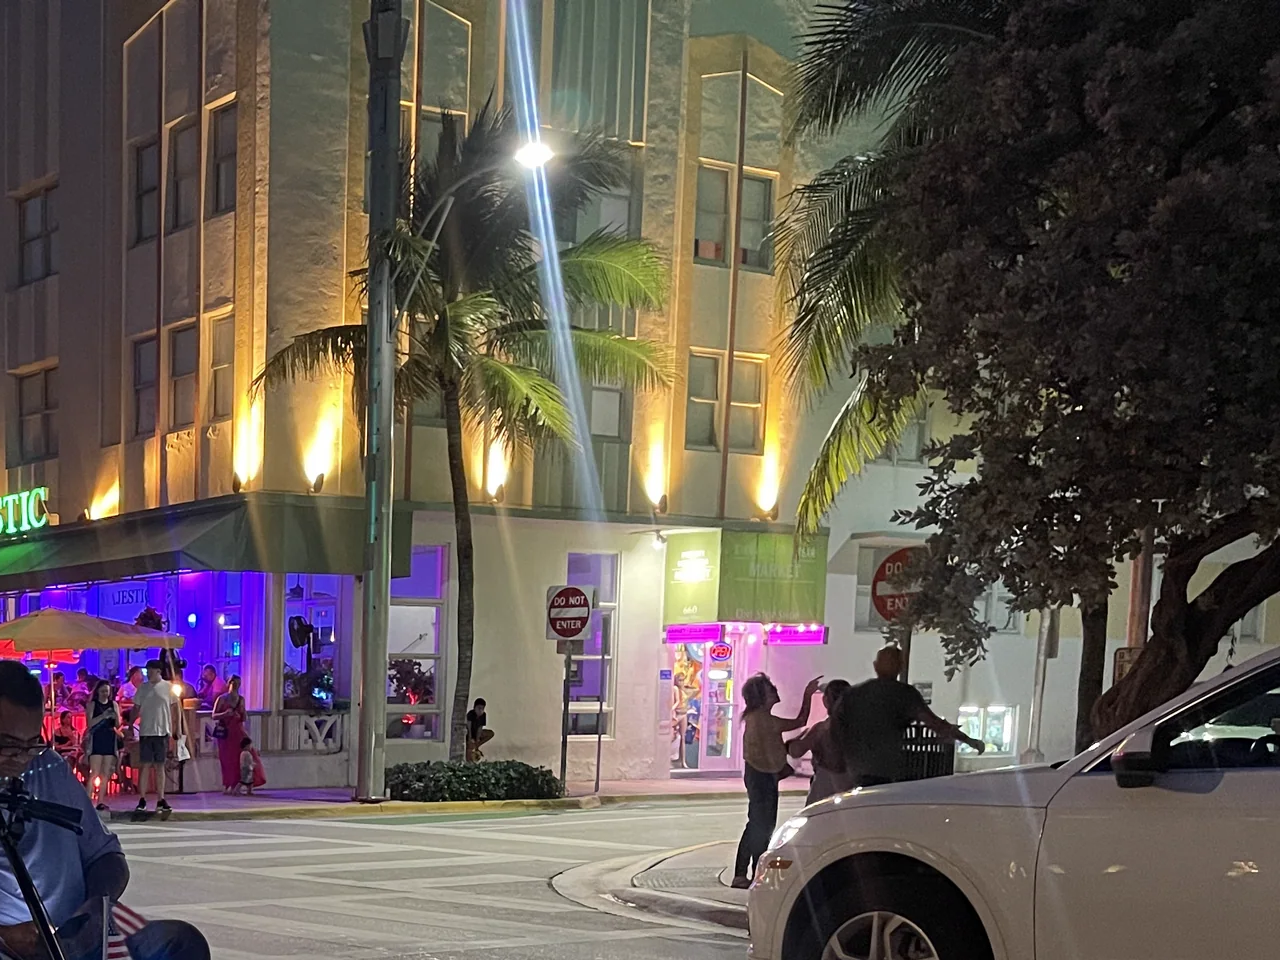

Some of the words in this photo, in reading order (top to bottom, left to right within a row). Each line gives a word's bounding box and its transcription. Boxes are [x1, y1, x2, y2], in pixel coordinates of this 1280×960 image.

[886, 562, 903, 574] DO
[554, 597, 565, 606] DO
[569, 595, 585, 605] NOT
[556, 620, 581, 629] ENTER
